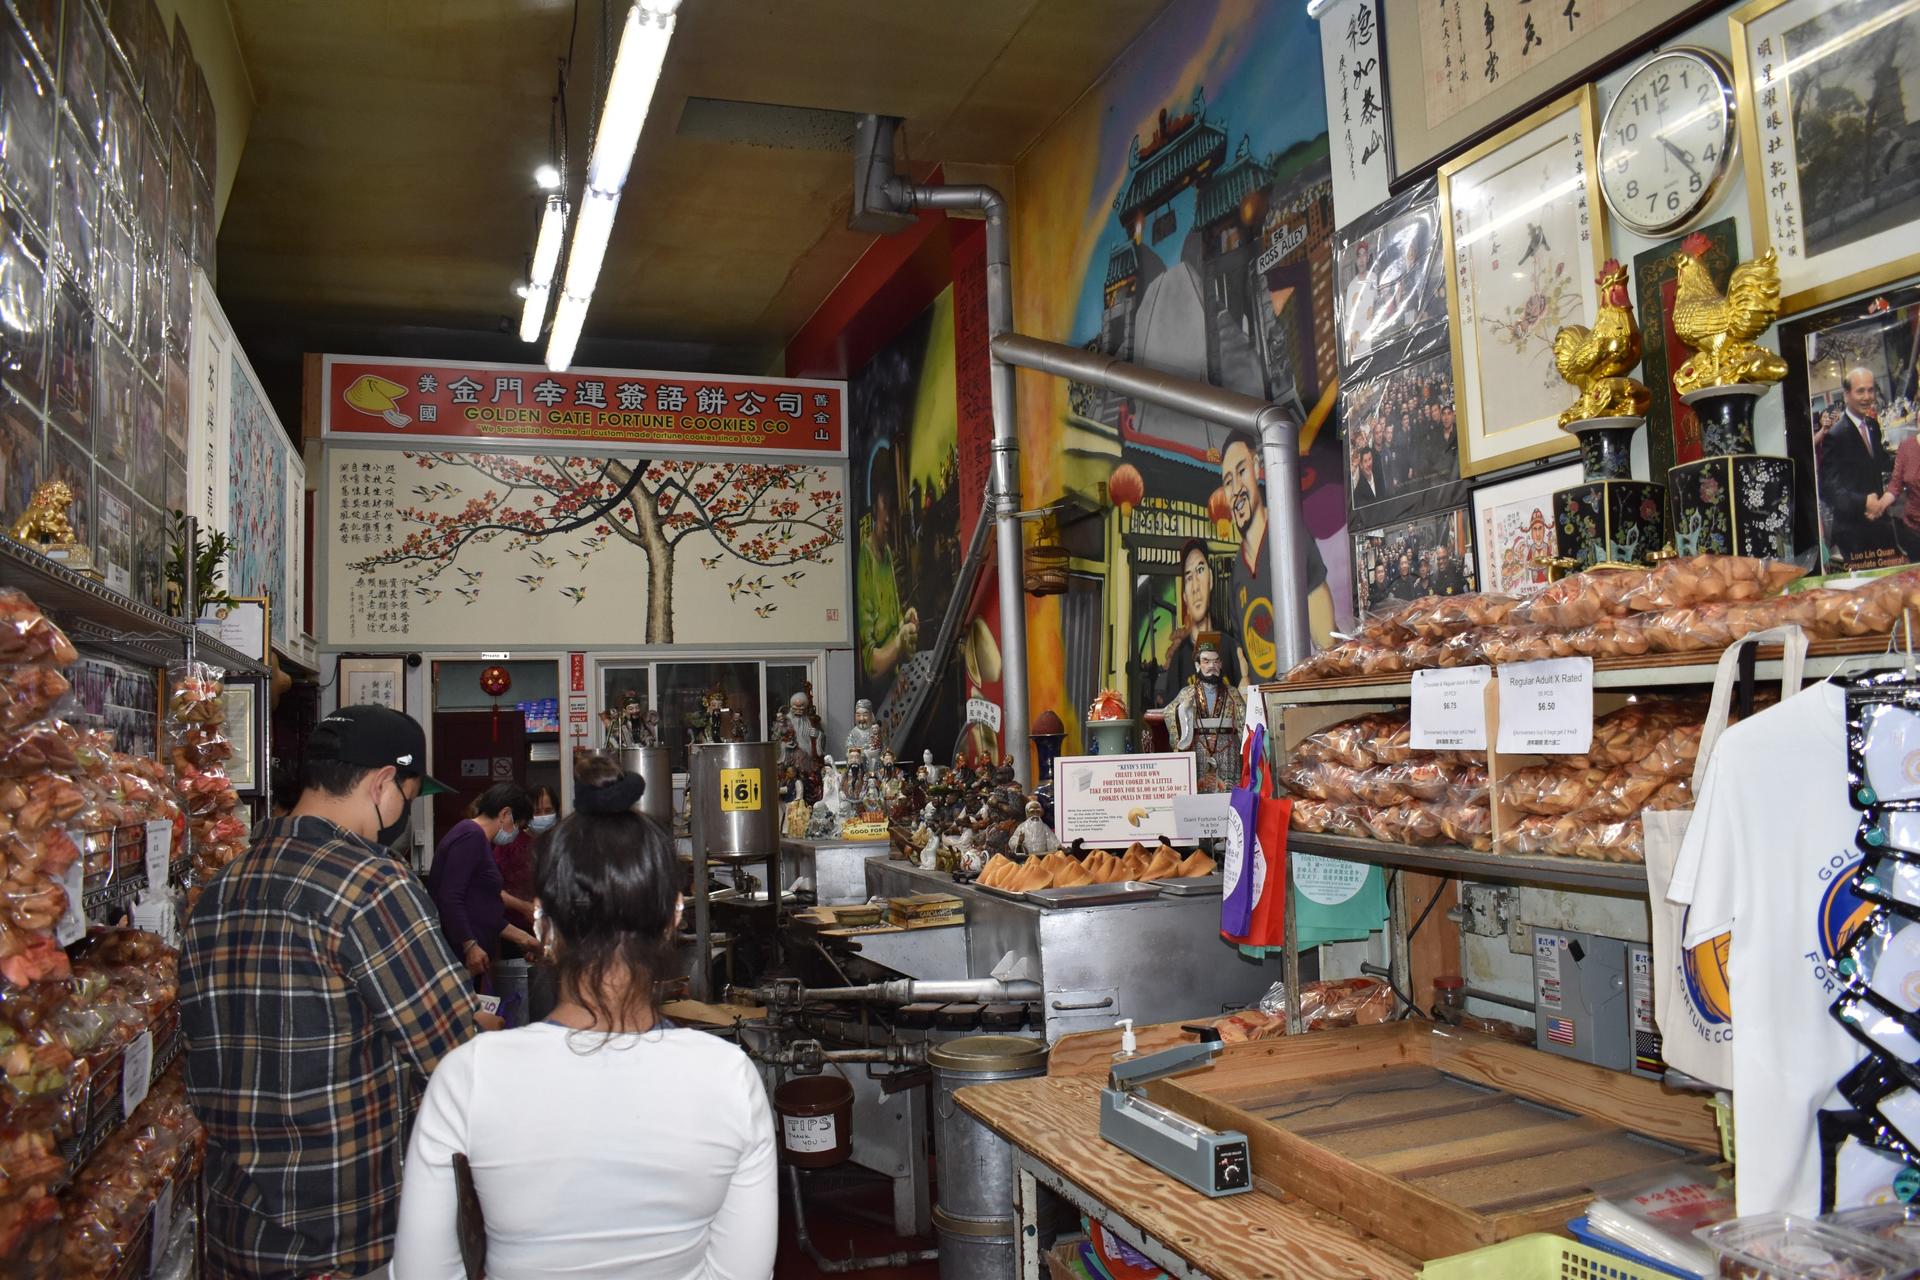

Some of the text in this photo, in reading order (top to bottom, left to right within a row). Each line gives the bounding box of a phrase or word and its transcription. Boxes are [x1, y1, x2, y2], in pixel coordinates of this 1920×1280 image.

[1650, 73, 1671, 97] 12
[1680, 70, 1688, 89] 1
[1697, 83, 1710, 105] 2
[1632, 94, 1648, 116] 11
[1707, 112, 1720, 131] 3
[1615, 123, 1637, 146] 10
[1703, 143, 1717, 162] 4
[1616, 155, 1629, 174] 9
[1626, 179, 1639, 199] 8
[1689, 172, 1703, 193] 5
[1646, 193, 1658, 213] 7
[1667, 190, 1680, 210] 6
[1273, 228, 1284, 243] 56
[1259, 227, 1304, 270] ROSS ALLEY
[418, 374, 439, 422] 美國
[464, 408, 789, 433] GOLDEN GATE FORTUNE COOKIES CO
[496, 425, 541, 435] Specialize
[580, 428, 591, 436] all
[593, 430, 624, 438] custom
[626, 430, 651, 439] made
[652, 432, 682, 440] fortune
[684, 433, 716, 441] cookies
[717, 434, 739, 442] since
[1864, 549, 1876, 559] Lin
[1876, 547, 1895, 557] Quan
[1509, 673, 1583, 688] Regular Adult X Rated
[1538, 702, 1555, 711] $6.50
[735, 784, 748, 800] 6
[484, 1001, 496, 1012] 5
[1676, 964, 1711, 1043] FORTUNE
[788, 1117, 831, 1131] TIPS
